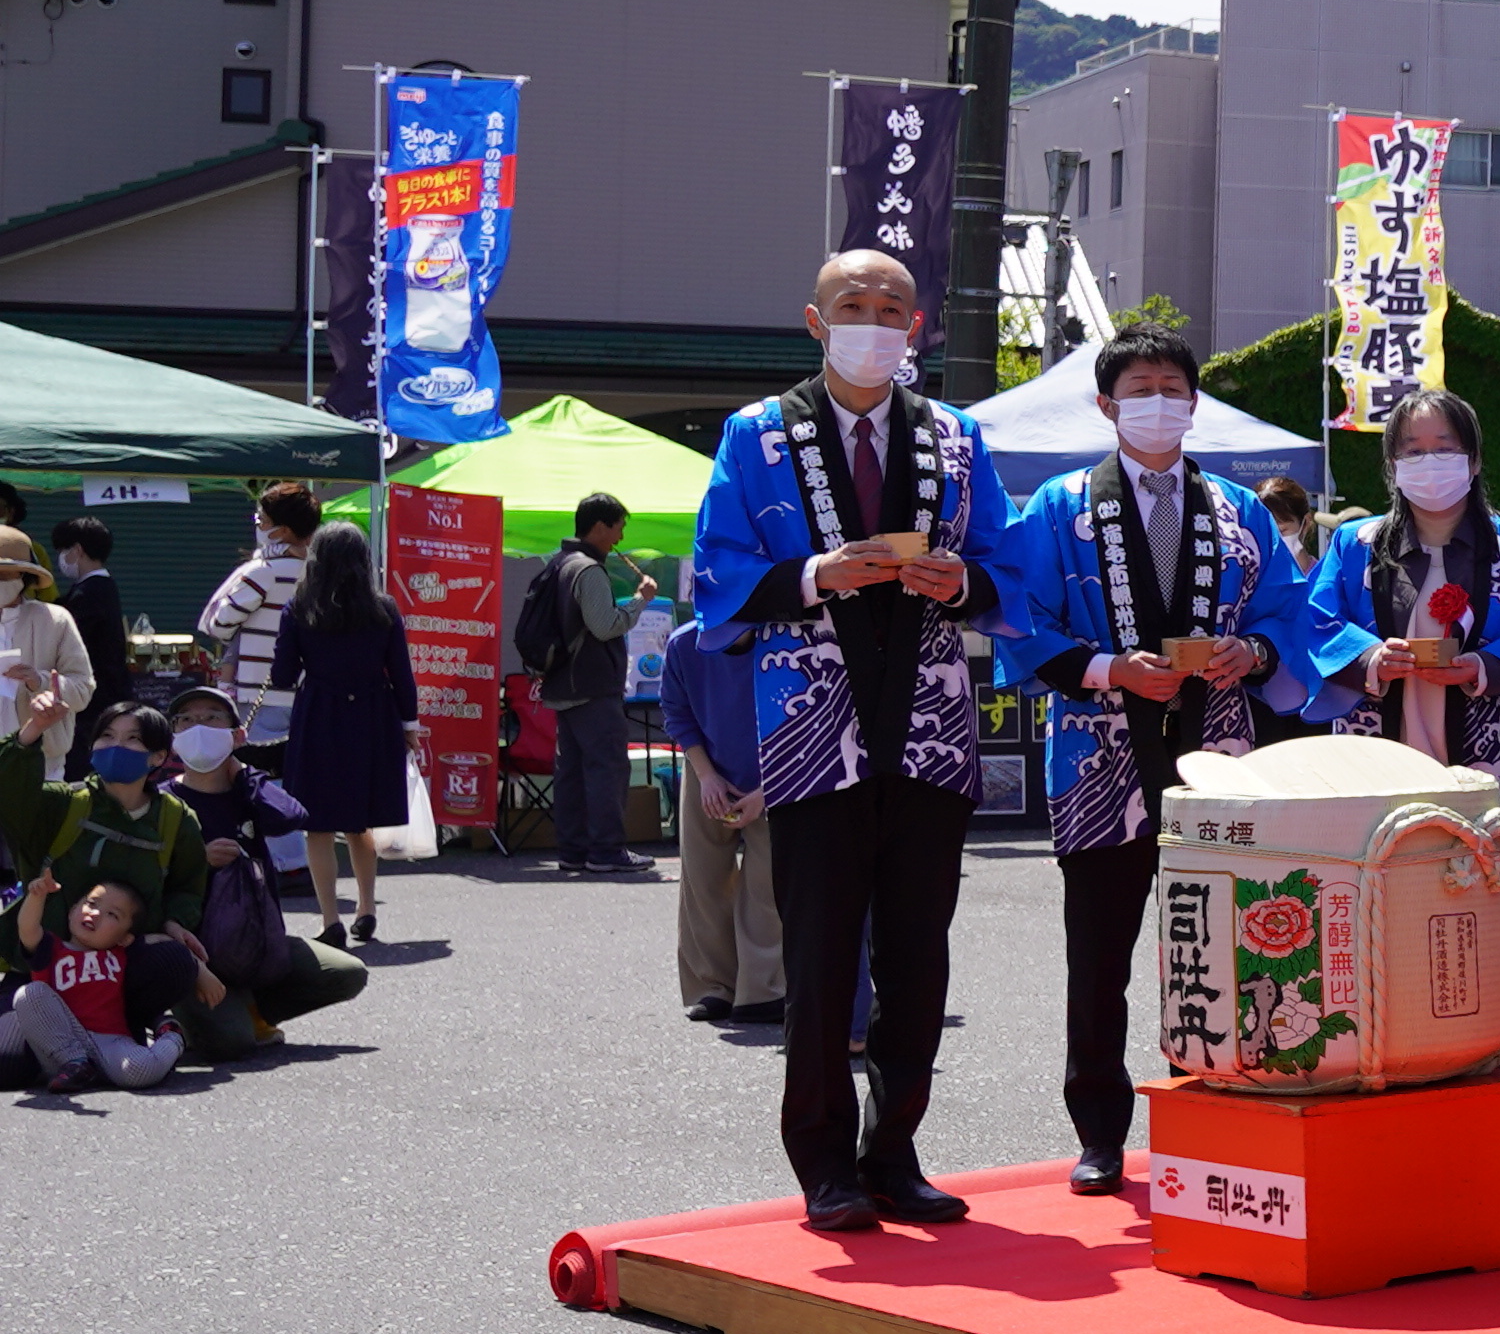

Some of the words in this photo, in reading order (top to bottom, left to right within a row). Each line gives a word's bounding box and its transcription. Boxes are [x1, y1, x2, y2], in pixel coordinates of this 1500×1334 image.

[428, 510, 464, 530] No.1
[980, 693, 1018, 734] ず
[448, 773, 479, 796] R-1
[54, 950, 122, 992] GAP
